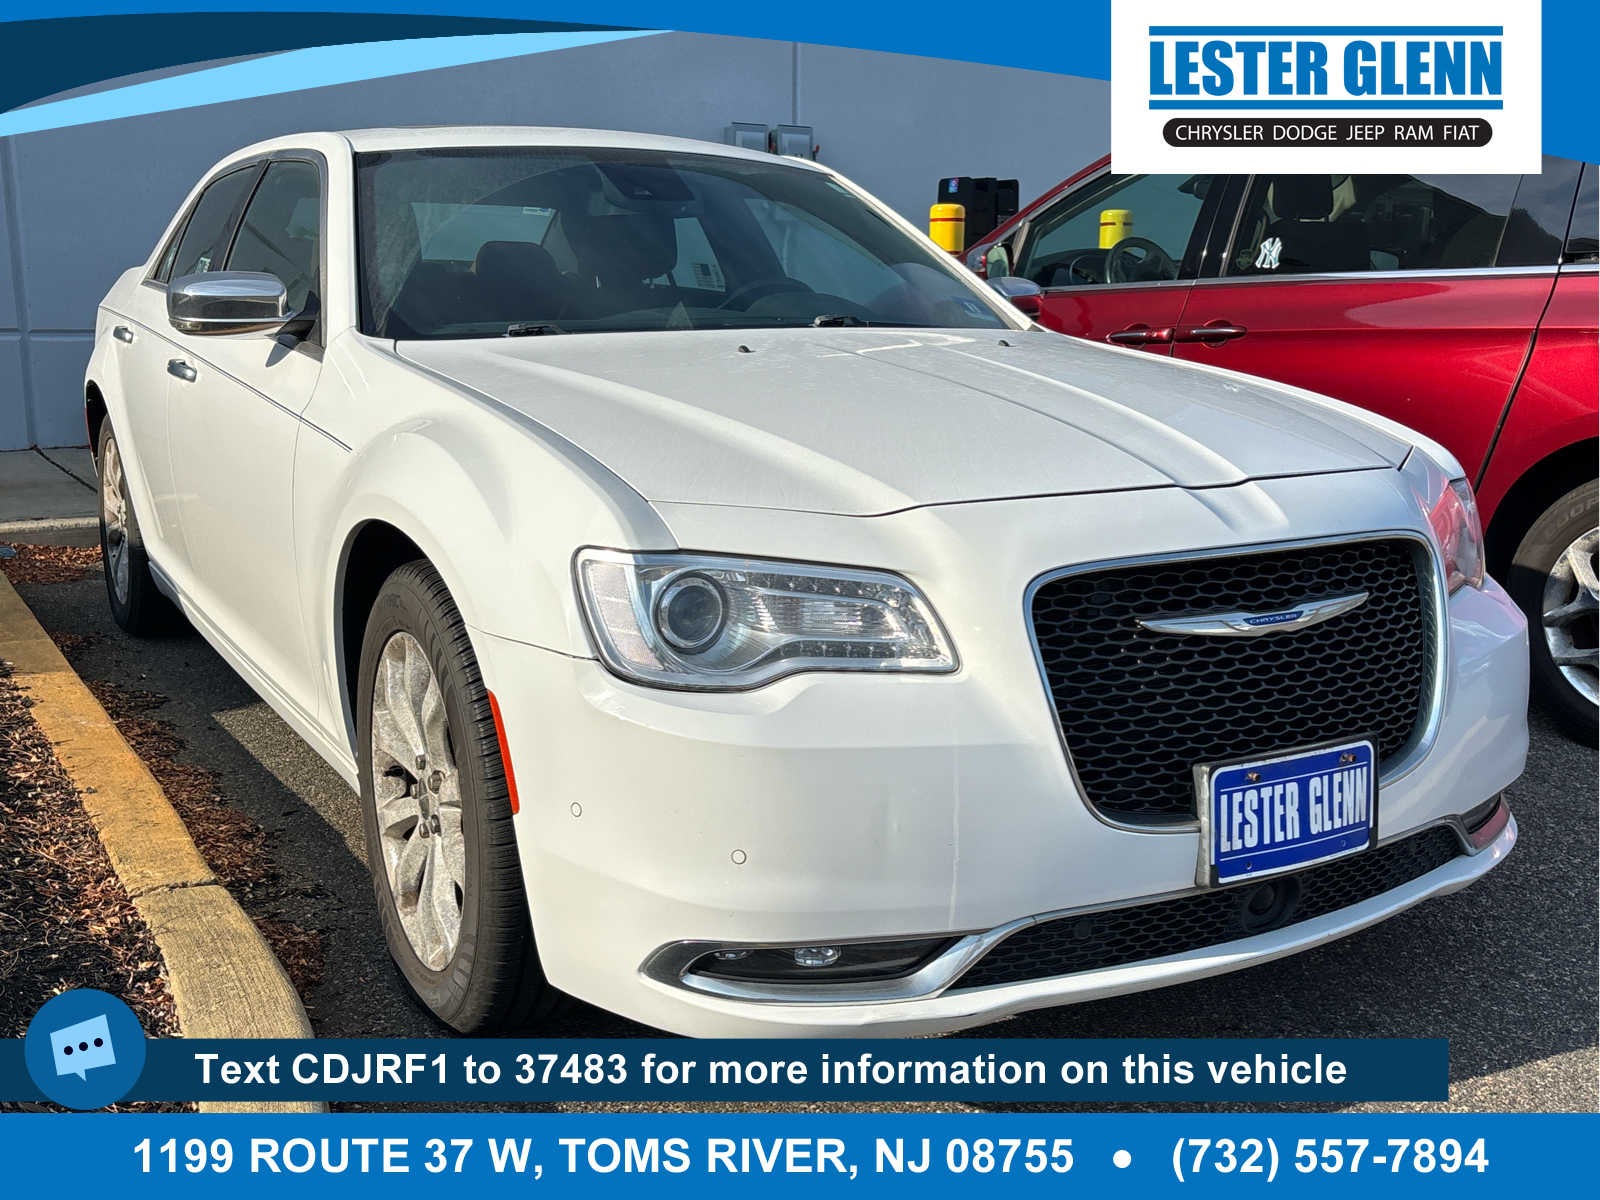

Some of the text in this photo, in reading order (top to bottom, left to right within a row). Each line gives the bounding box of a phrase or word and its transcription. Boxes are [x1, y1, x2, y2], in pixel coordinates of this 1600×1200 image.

[1249, 613, 1298, 625] CHRYSLER
[1220, 766, 1368, 853] LESTER GLENN
